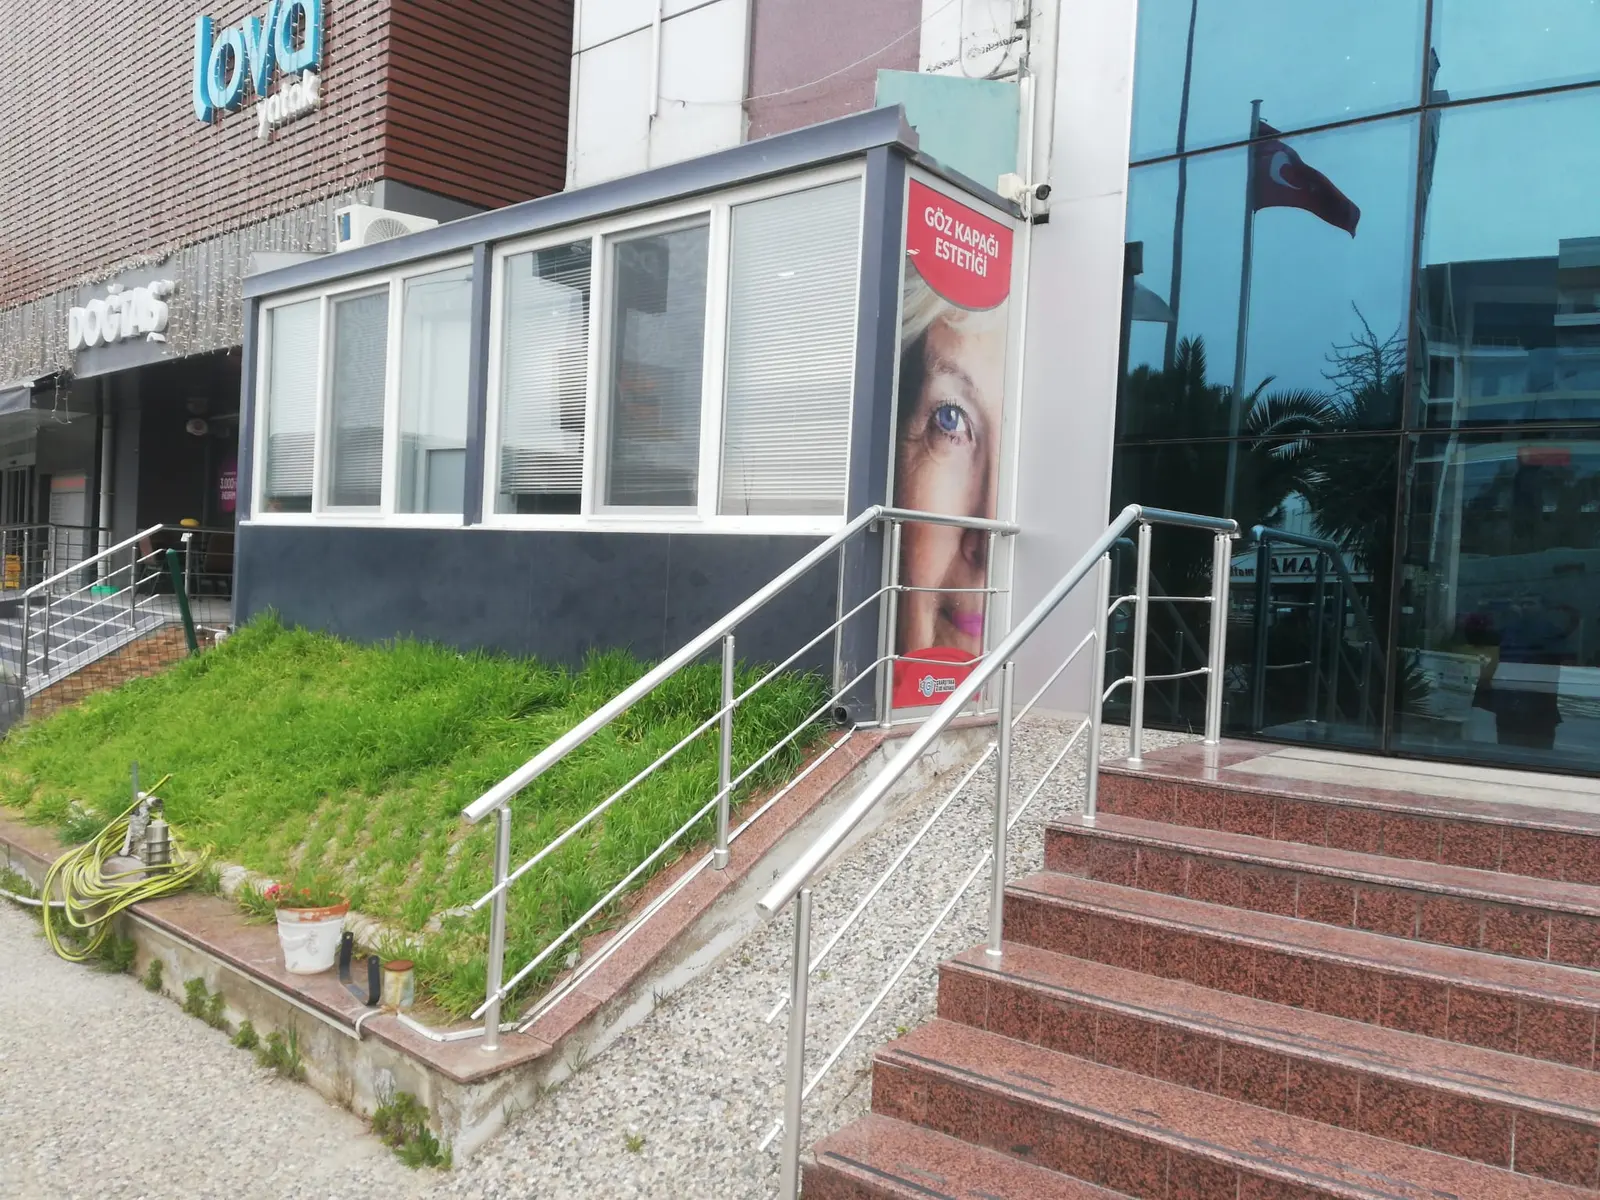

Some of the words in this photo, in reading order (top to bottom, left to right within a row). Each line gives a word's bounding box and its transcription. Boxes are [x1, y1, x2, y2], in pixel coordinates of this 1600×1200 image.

[256, 68, 321, 139] yatak
[924, 206, 953, 236] GÖZ
[955, 220, 999, 258] KAPAĞI
[935, 237, 988, 277] ESTETİĞİ
[69, 279, 174, 351] DOĞTAŞ
